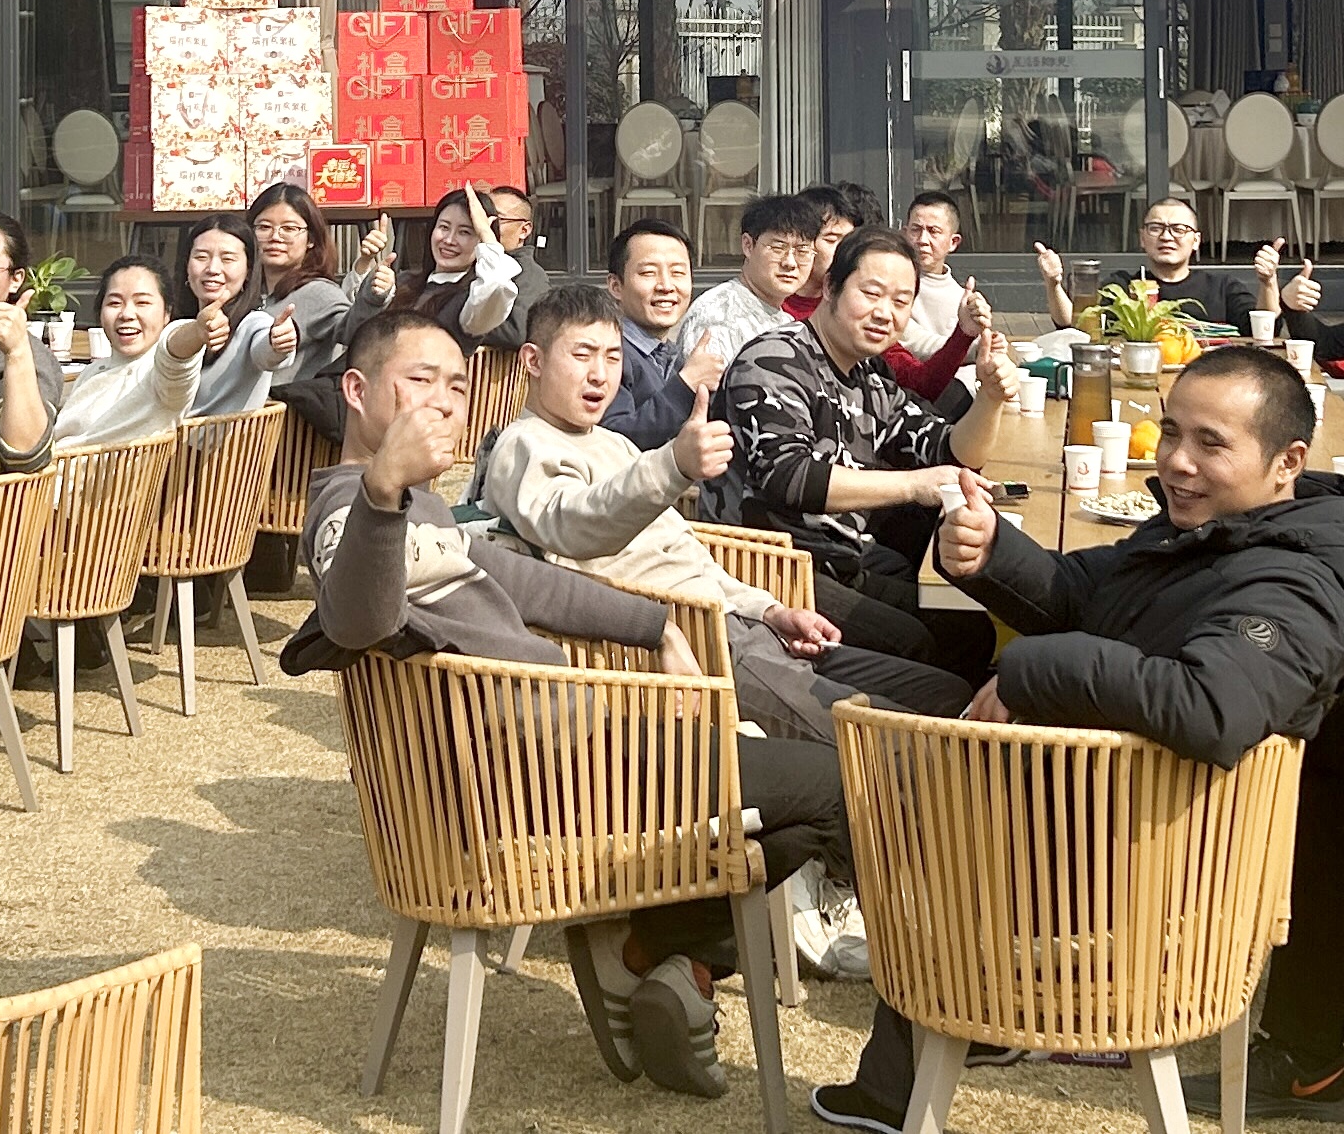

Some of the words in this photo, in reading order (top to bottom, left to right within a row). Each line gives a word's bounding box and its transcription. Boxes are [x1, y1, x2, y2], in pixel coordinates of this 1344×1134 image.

[347, 12, 418, 37] GIFT
[437, 9, 501, 35] GIFT
[357, 51, 408, 76] 礼盒
[447, 50, 496, 75] 礼盒
[346, 75, 414, 100] GIFT
[431, 73, 498, 100] GIFT
[356, 115, 405, 140] 礼盒
[440, 114, 491, 139] 礼盒
[369, 139, 414, 165] IFT
[434, 137, 503, 164] GIFT
[373, 180, 405, 206] 盒
